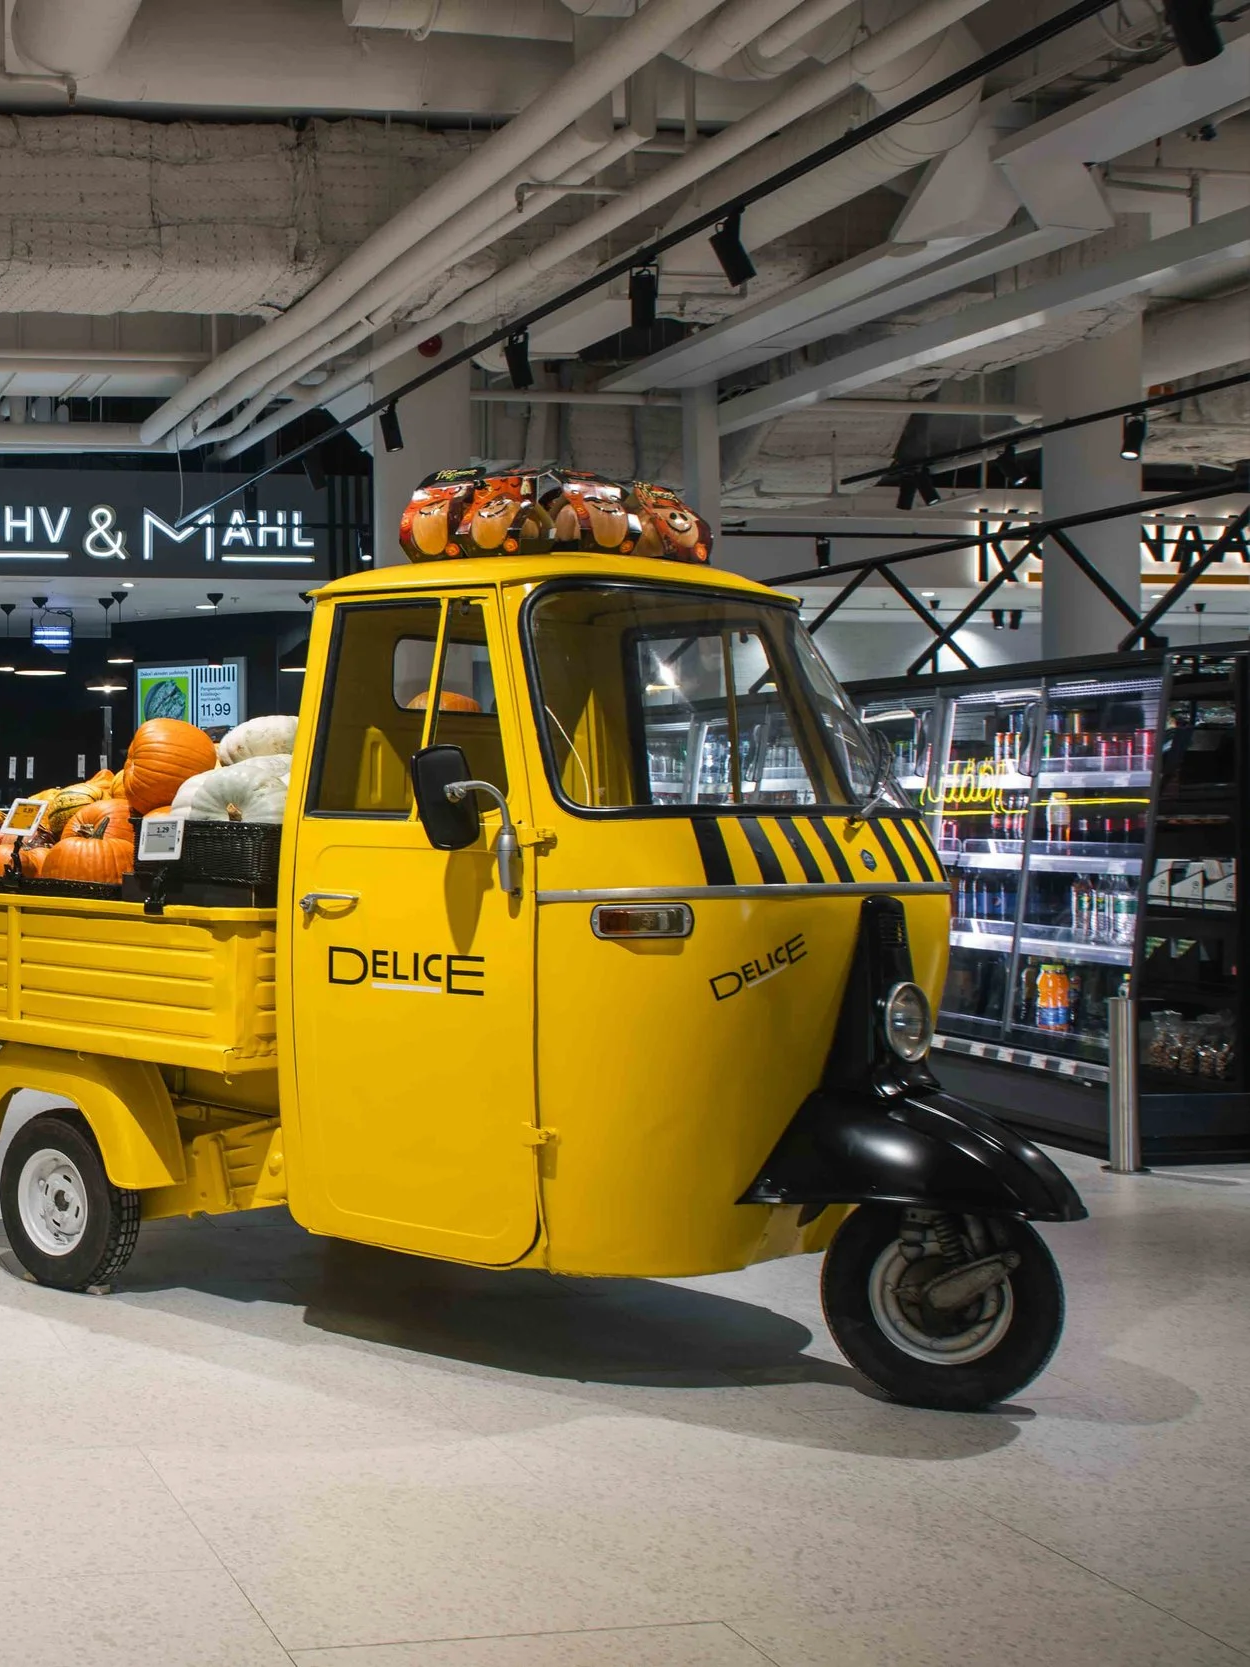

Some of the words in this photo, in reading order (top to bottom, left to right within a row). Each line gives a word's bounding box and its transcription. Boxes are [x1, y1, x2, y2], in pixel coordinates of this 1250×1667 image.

[81, 504, 130, 561] &
[143, 506, 316, 562] MAHL
[200, 703, 231, 717] 11,99
[328, 945, 485, 997] DELICE
[708, 933, 808, 1002] DELICE
